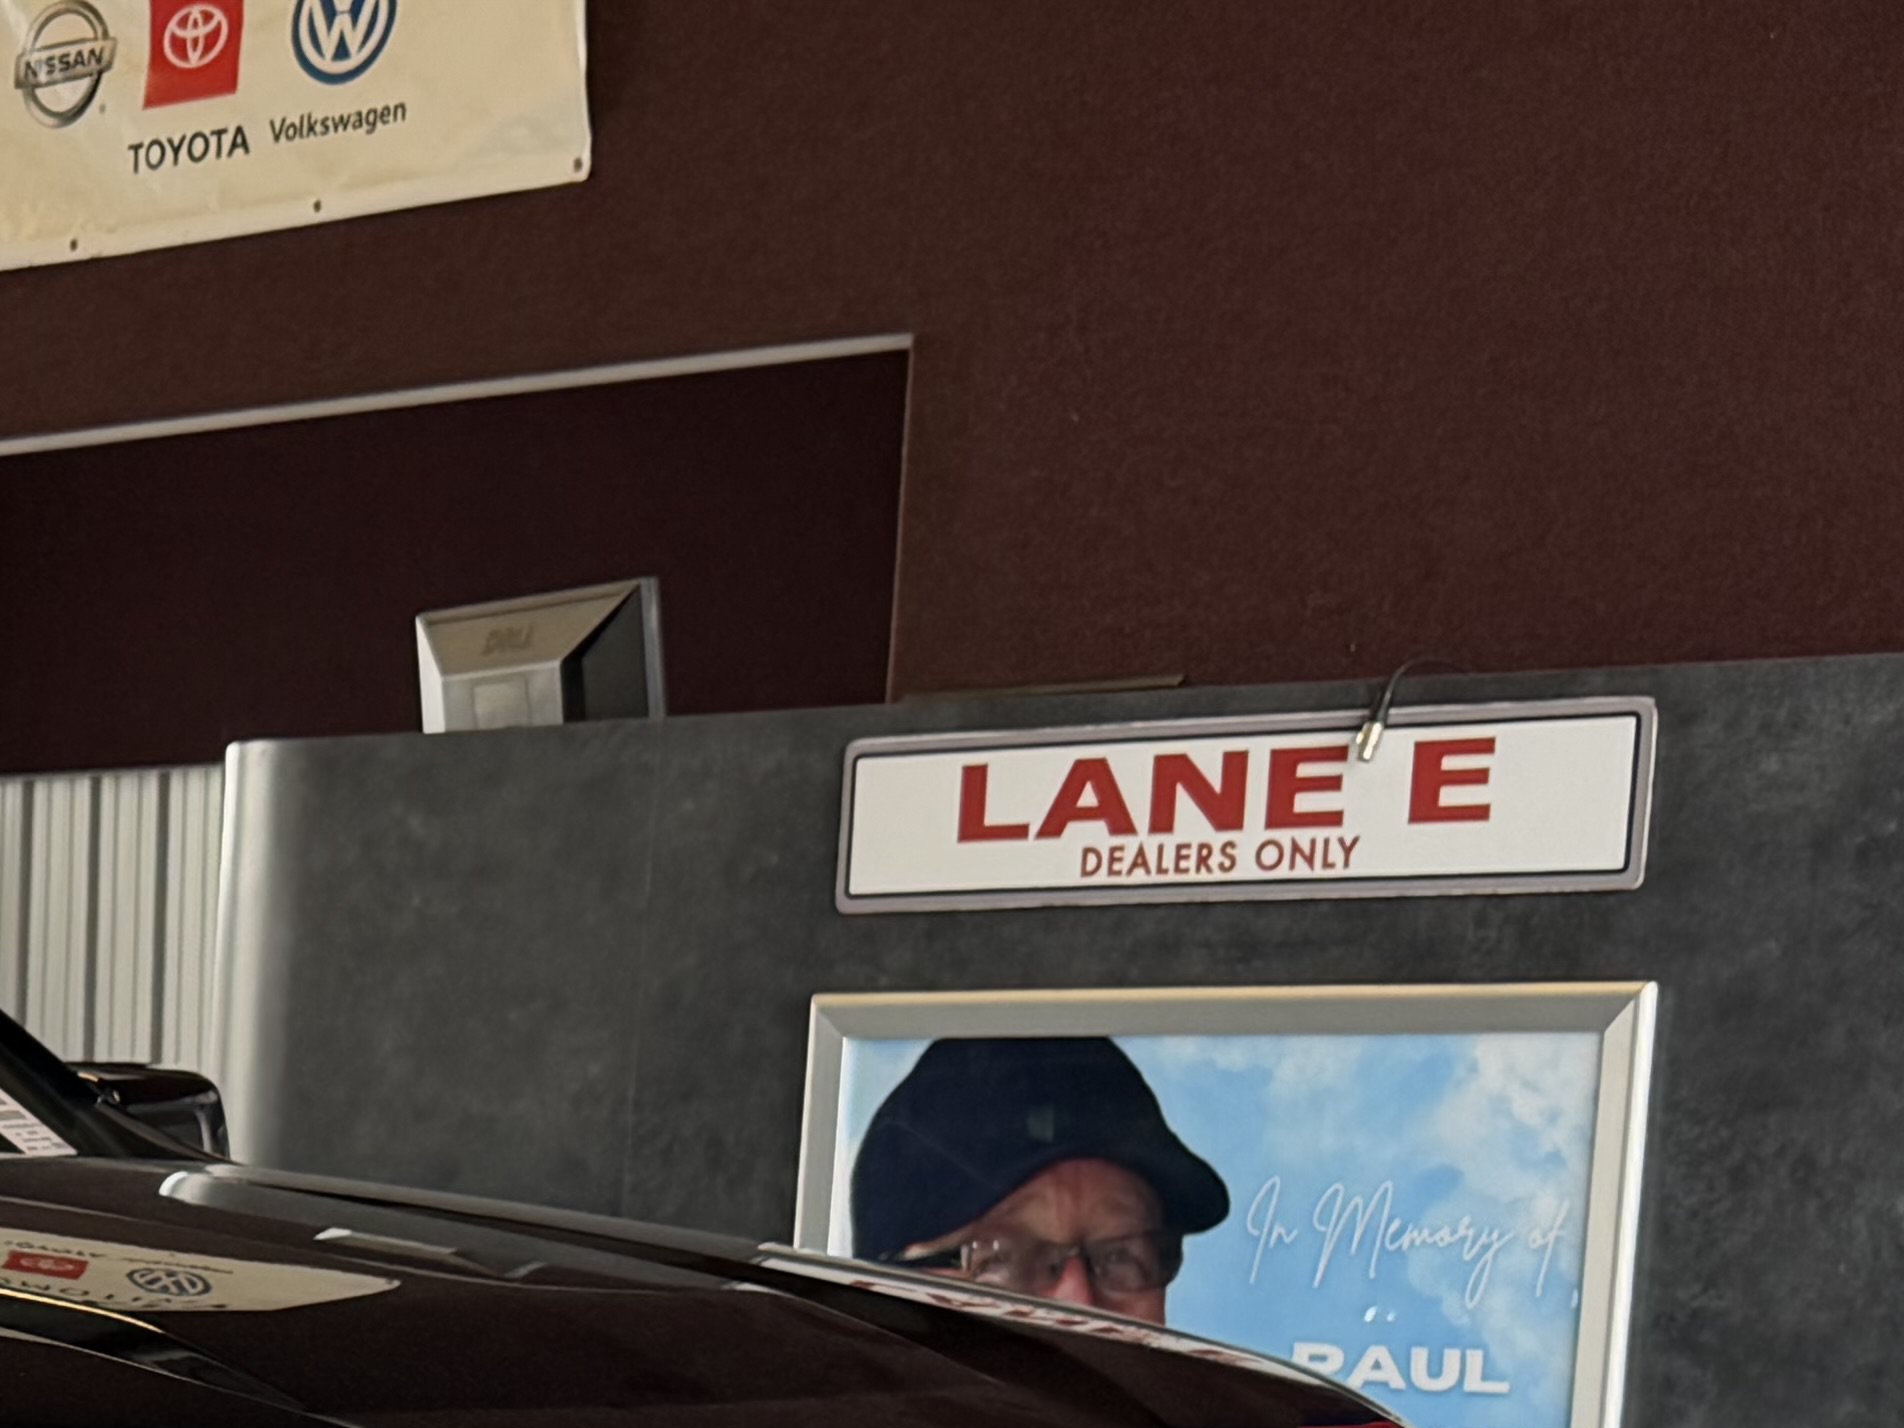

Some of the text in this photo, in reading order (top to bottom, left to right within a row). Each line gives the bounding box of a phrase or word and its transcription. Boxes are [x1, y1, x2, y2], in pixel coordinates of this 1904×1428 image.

[24, 48, 104, 81] NISSAN
[269, 102, 407, 144] Volkswagen
[128, 125, 250, 175] TOYOTA
[958, 736, 1497, 843] LANE E
[1081, 835, 1361, 878] DEALERS ONLY
[1247, 1175, 1570, 1310] In Memory of
[1293, 1341, 1510, 1394] PAUL
